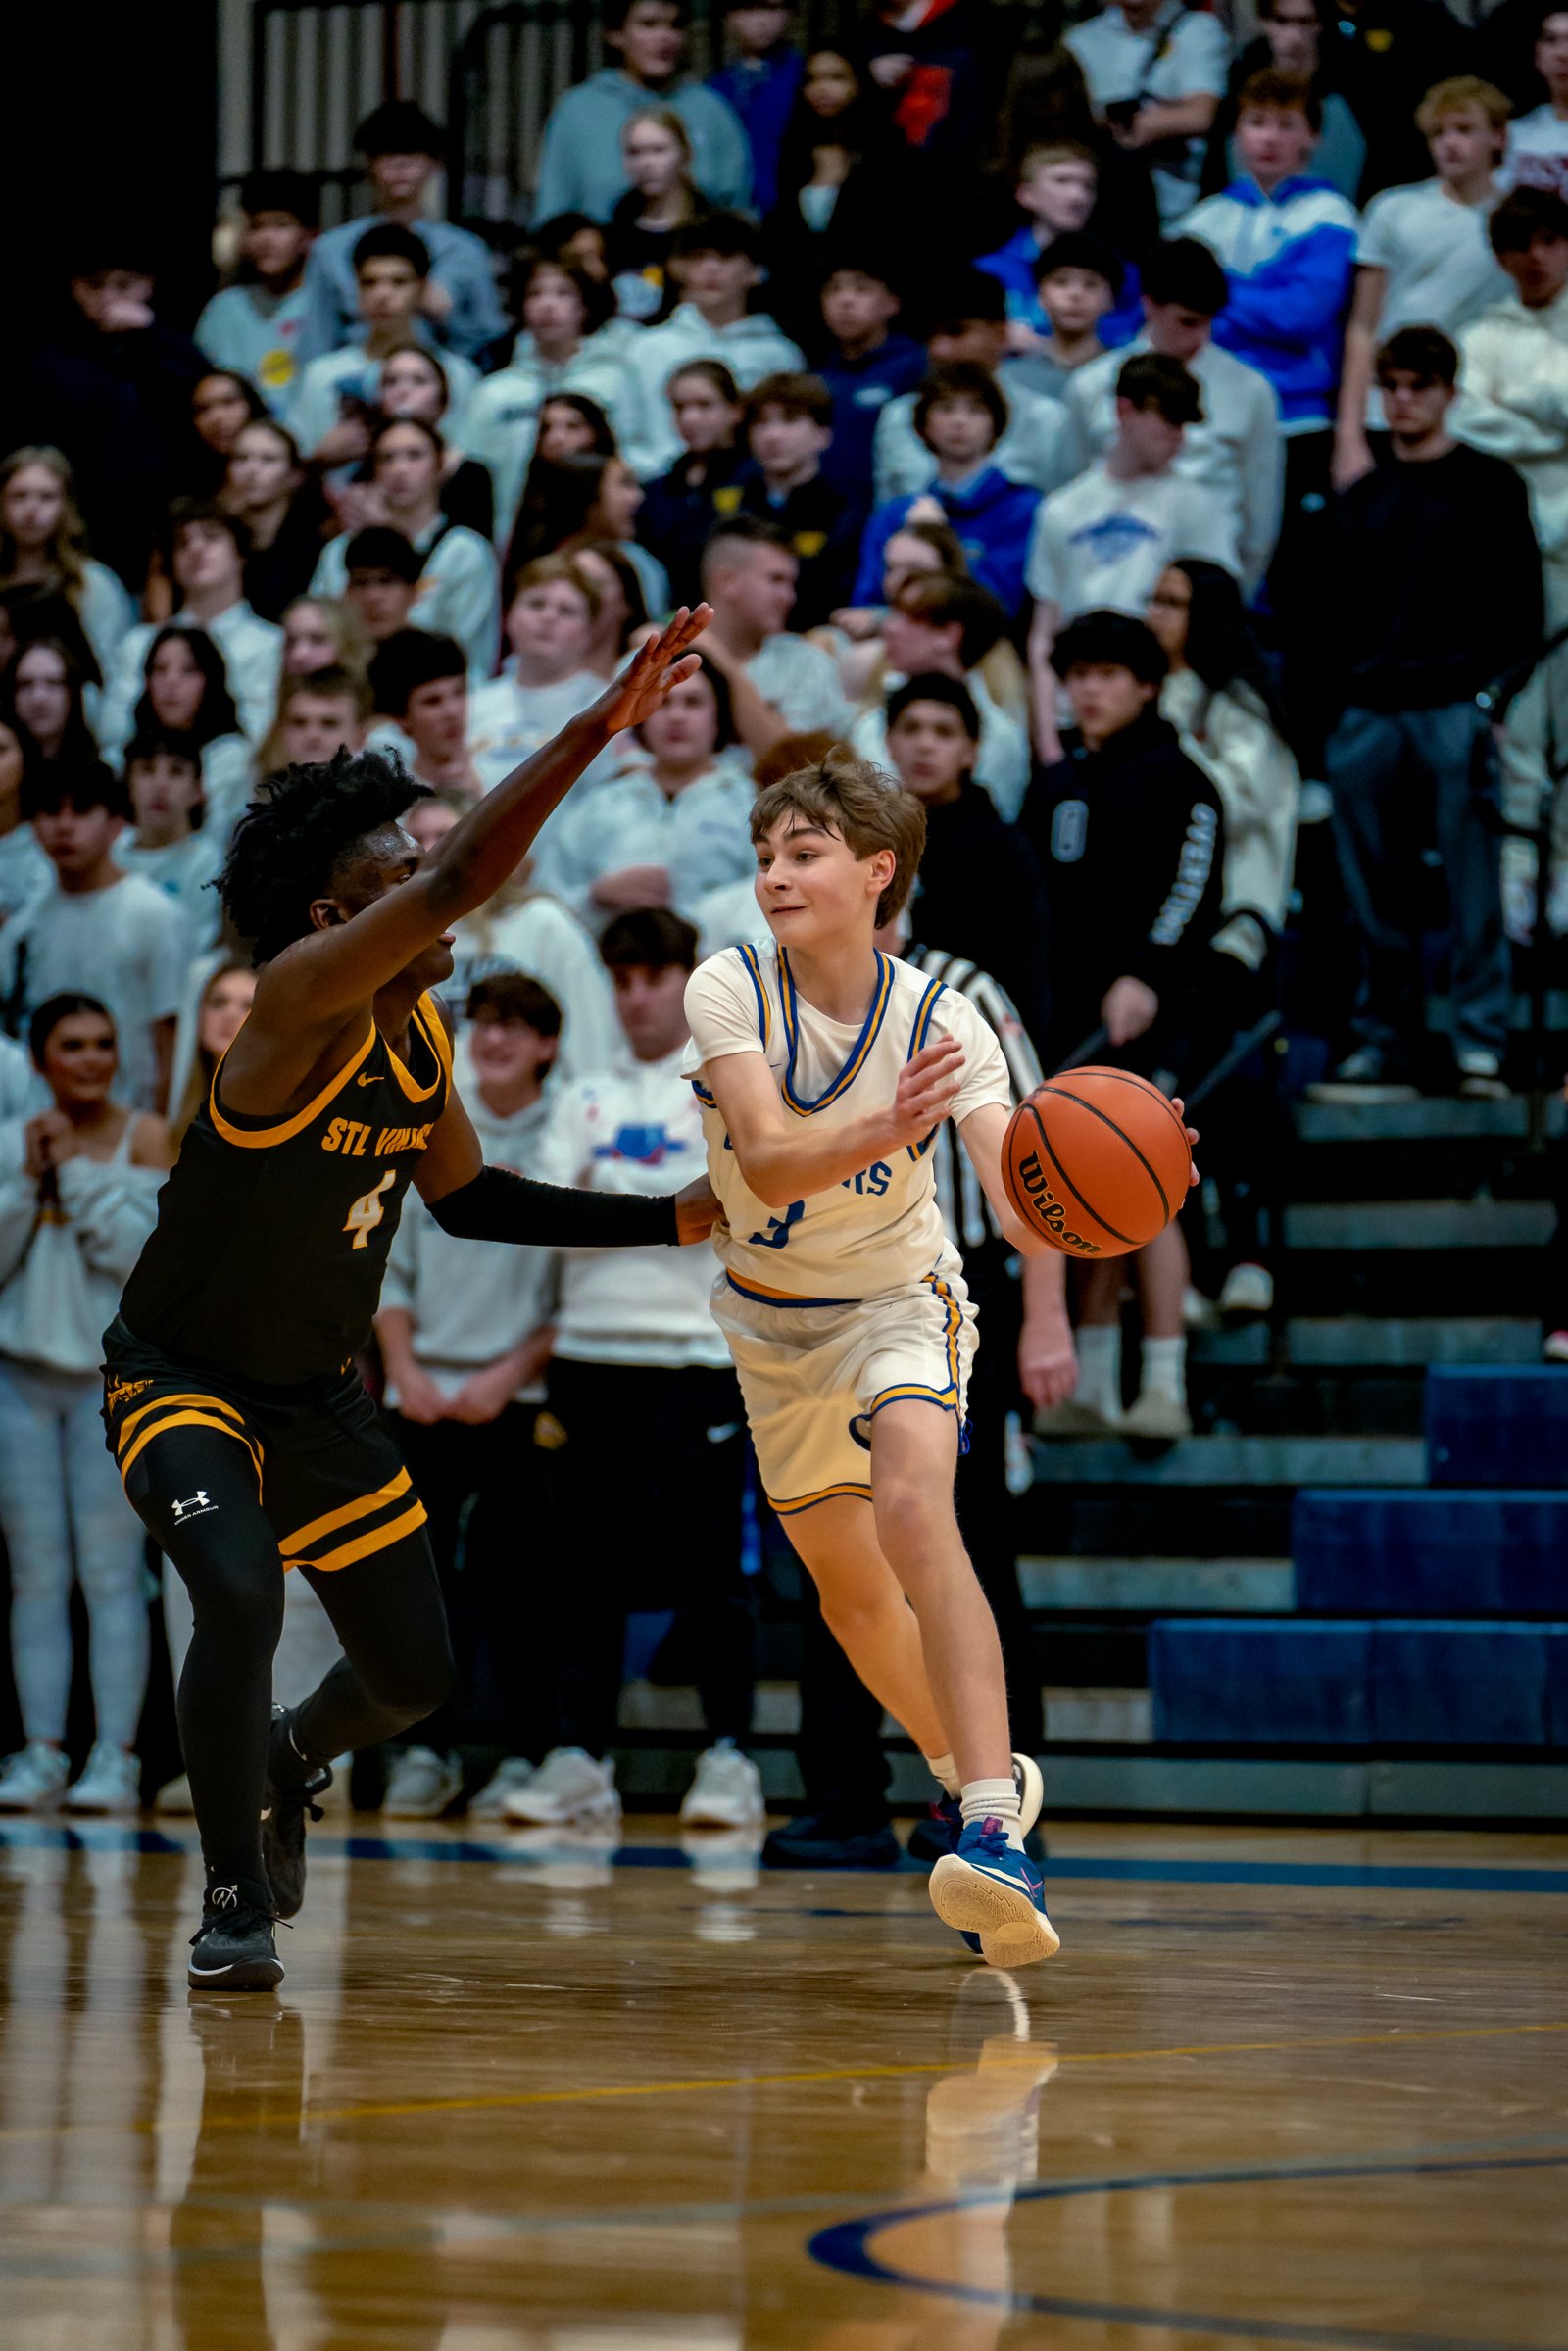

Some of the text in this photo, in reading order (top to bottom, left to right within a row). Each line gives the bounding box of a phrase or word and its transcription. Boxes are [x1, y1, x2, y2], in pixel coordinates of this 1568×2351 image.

[321, 1116, 372, 1156] STL
[342, 1169, 397, 1249] 4
[1018, 1149, 1102, 1254] Wilson
